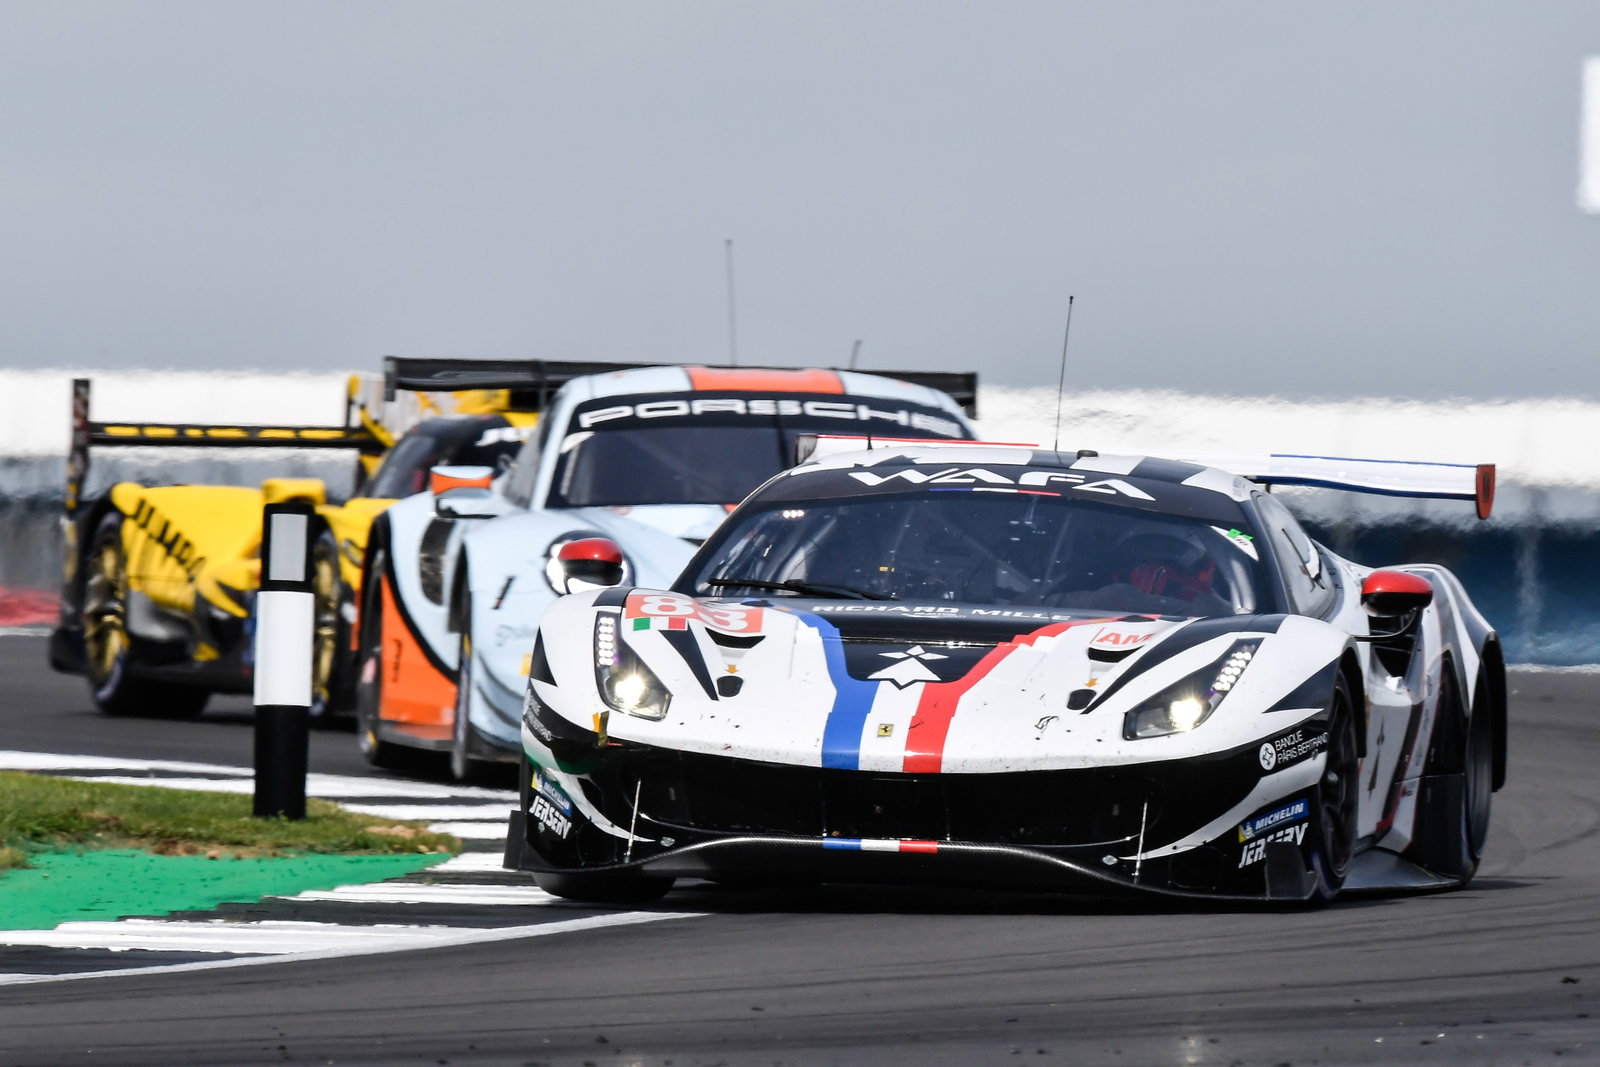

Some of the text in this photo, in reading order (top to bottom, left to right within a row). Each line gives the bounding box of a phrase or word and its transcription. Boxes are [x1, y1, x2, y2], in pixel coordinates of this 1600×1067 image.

[580, 399, 962, 438] PORSCHE
[848, 468, 1156, 501] WAFA
[639, 595, 749, 631] 83
[811, 605, 960, 614] RICHARD
[971, 608, 1071, 621] MILLE
[1097, 632, 1155, 645] AM
[1275, 730, 1303, 751] BANQUE
[1255, 803, 1304, 830] MICHELIN
